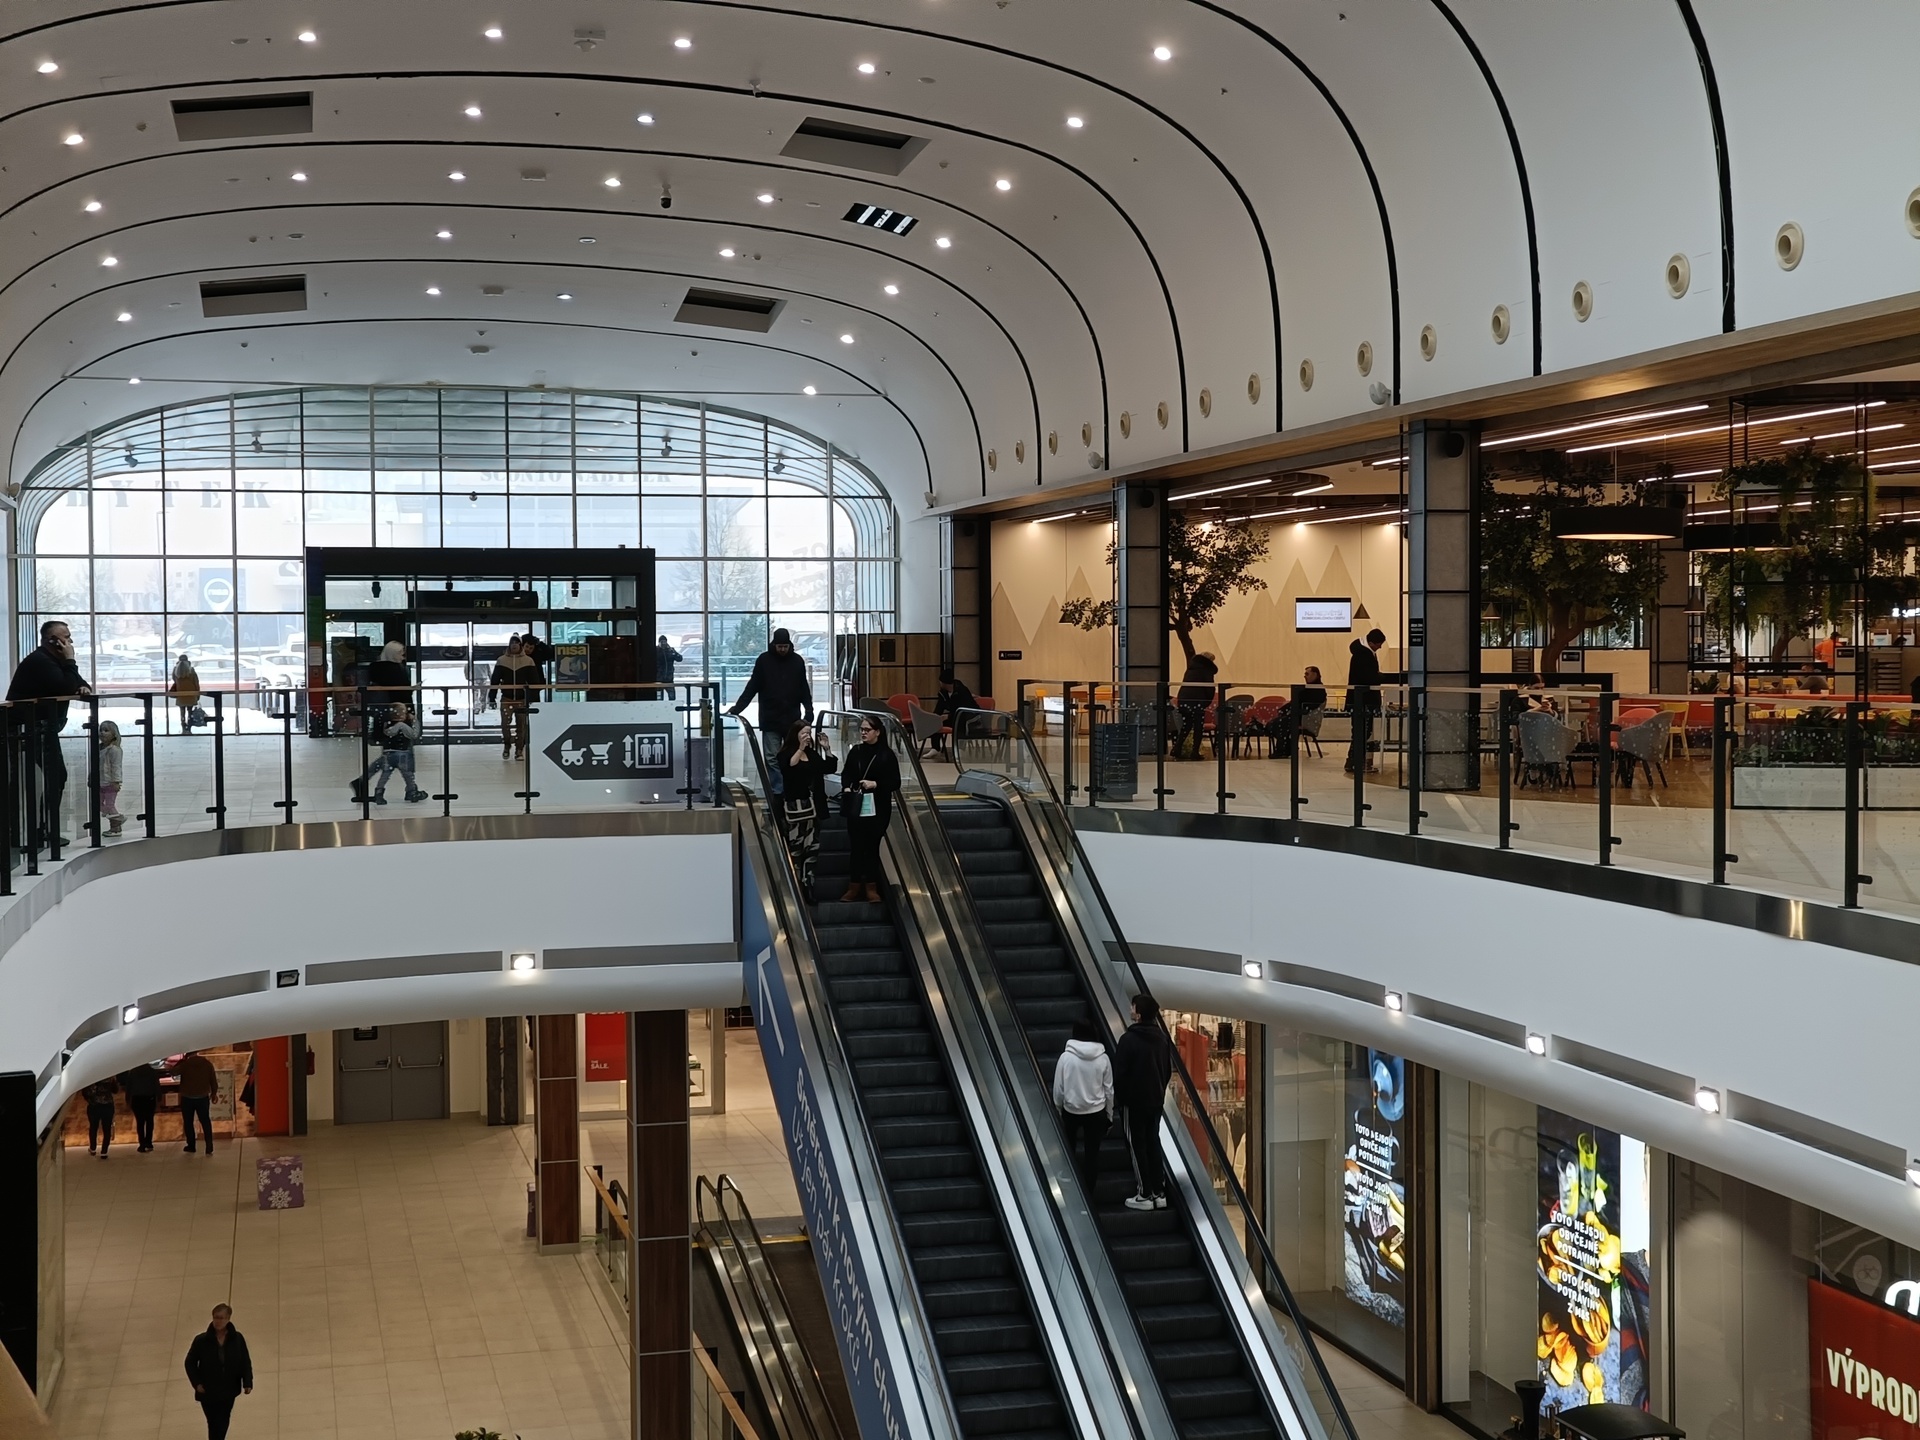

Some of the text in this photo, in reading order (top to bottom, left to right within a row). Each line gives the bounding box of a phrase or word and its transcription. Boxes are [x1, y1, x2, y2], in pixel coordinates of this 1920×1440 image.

[557, 645, 587, 656] nisa
[1355, 1123, 1370, 1137] TOTO
[1358, 1149, 1391, 1170] POTRAVINY
[1358, 1173, 1391, 1196] TOTO JSOU
[1551, 1210, 1604, 1242] TOTO NEJSOU
[791, 1105, 864, 1393] Už jen pár kroků.
[795, 1066, 906, 1440] Směrem k novým chut
[1556, 1240, 1600, 1268] POTRAVINY
[1558, 1227, 1598, 1254] OBYČEJNÉ
[1556, 1283, 1600, 1309] POTRAVINY
[1557, 1268, 1600, 1297] TOTO JSOU
[1566, 1301, 1573, 1312] Z
[1826, 1347, 1920, 1428] VÝPROD
